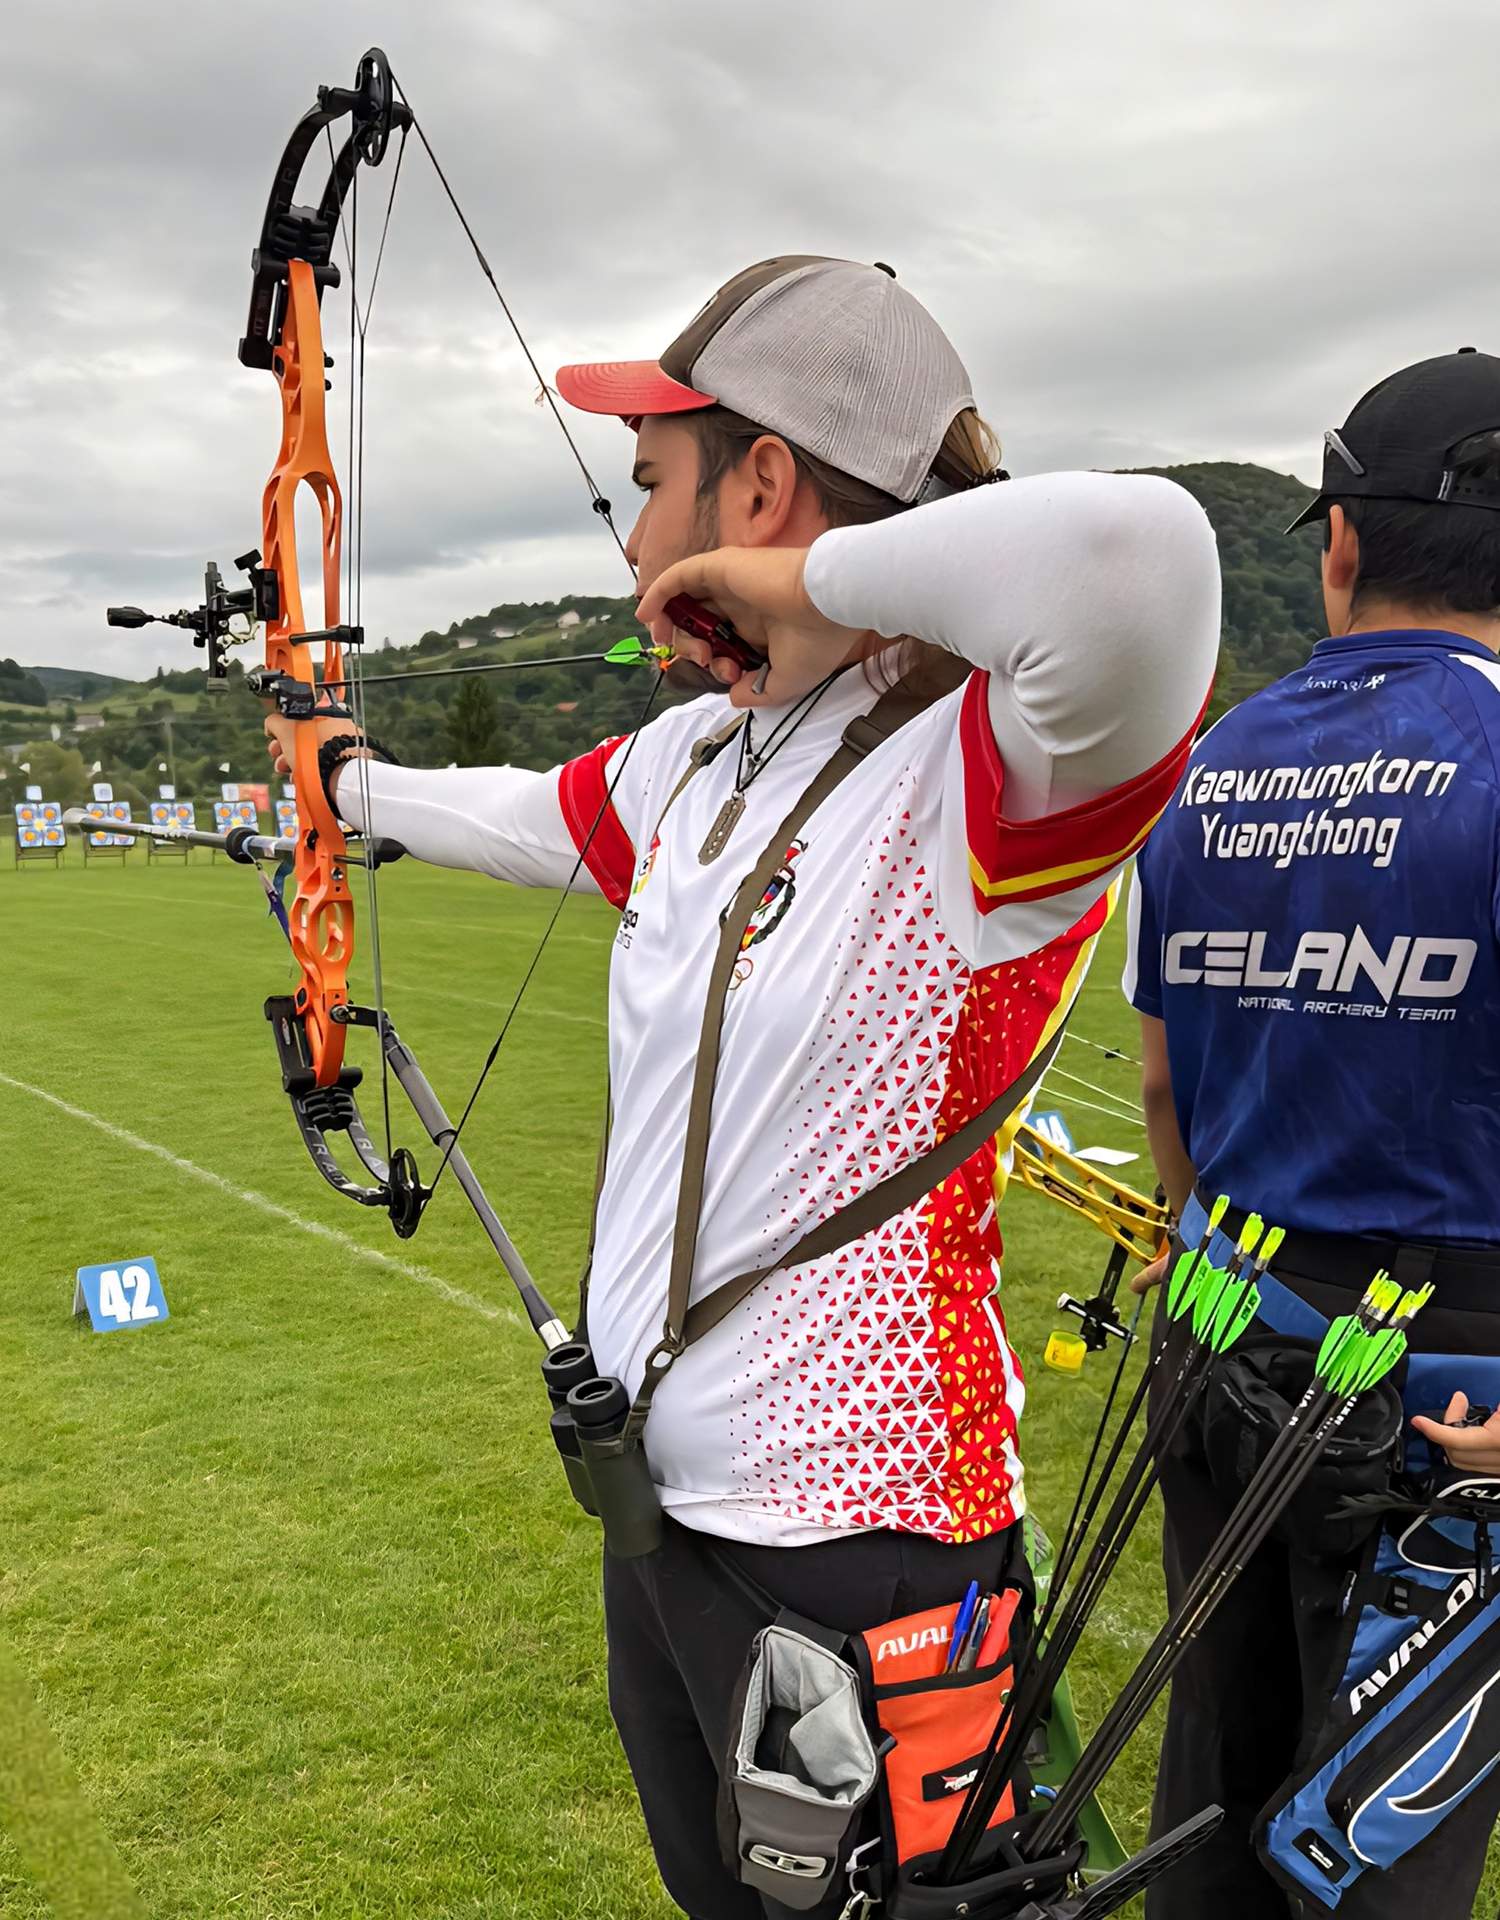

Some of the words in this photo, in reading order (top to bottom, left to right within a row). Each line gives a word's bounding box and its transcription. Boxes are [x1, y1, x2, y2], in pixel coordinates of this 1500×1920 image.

[1178, 749, 1459, 808] Kaewmungkorn
[1201, 809, 1402, 868] Yuangthong
[1161, 924, 1478, 1004] CELAND
[1237, 996, 1295, 1011] NATIOAL
[1303, 1001, 1388, 1018] ARCHERY
[1397, 1007, 1457, 1021] TEAM
[99, 1265, 160, 1324] 42
[876, 1625, 953, 1662] AVAL
[1350, 1573, 1477, 1716] AVALO
